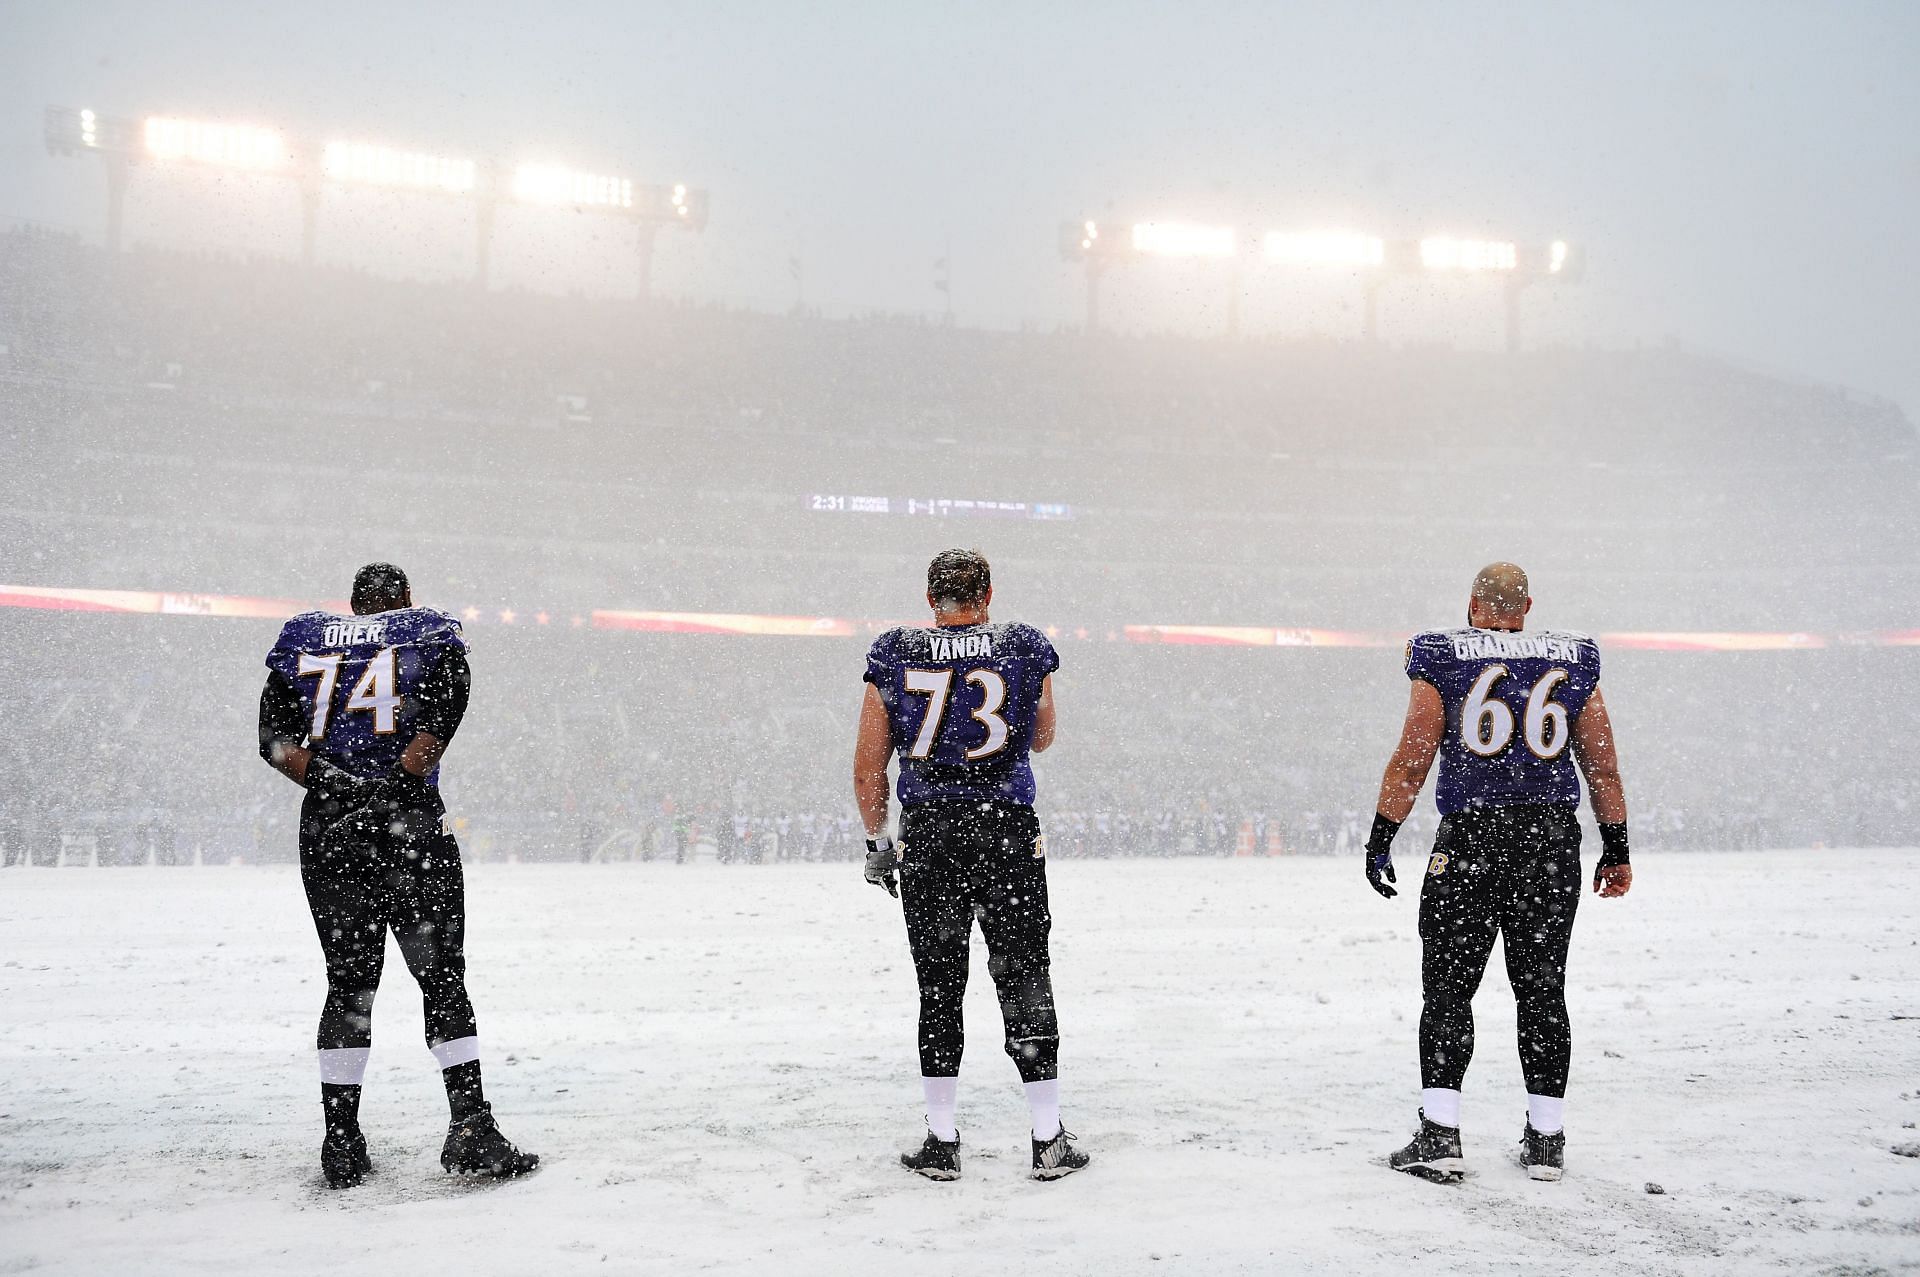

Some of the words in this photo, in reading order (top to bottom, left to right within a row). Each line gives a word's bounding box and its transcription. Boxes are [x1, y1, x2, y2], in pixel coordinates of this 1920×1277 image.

[813, 495, 844, 510] 2:31
[324, 623, 382, 647] OHER
[930, 634, 992, 660] YANDA
[1453, 634, 1580, 663] GRADKOWSKI
[297, 646, 403, 742] 74
[904, 667, 1010, 761] 73
[1461, 663, 1569, 760] 66
[1428, 852, 1449, 875] B
